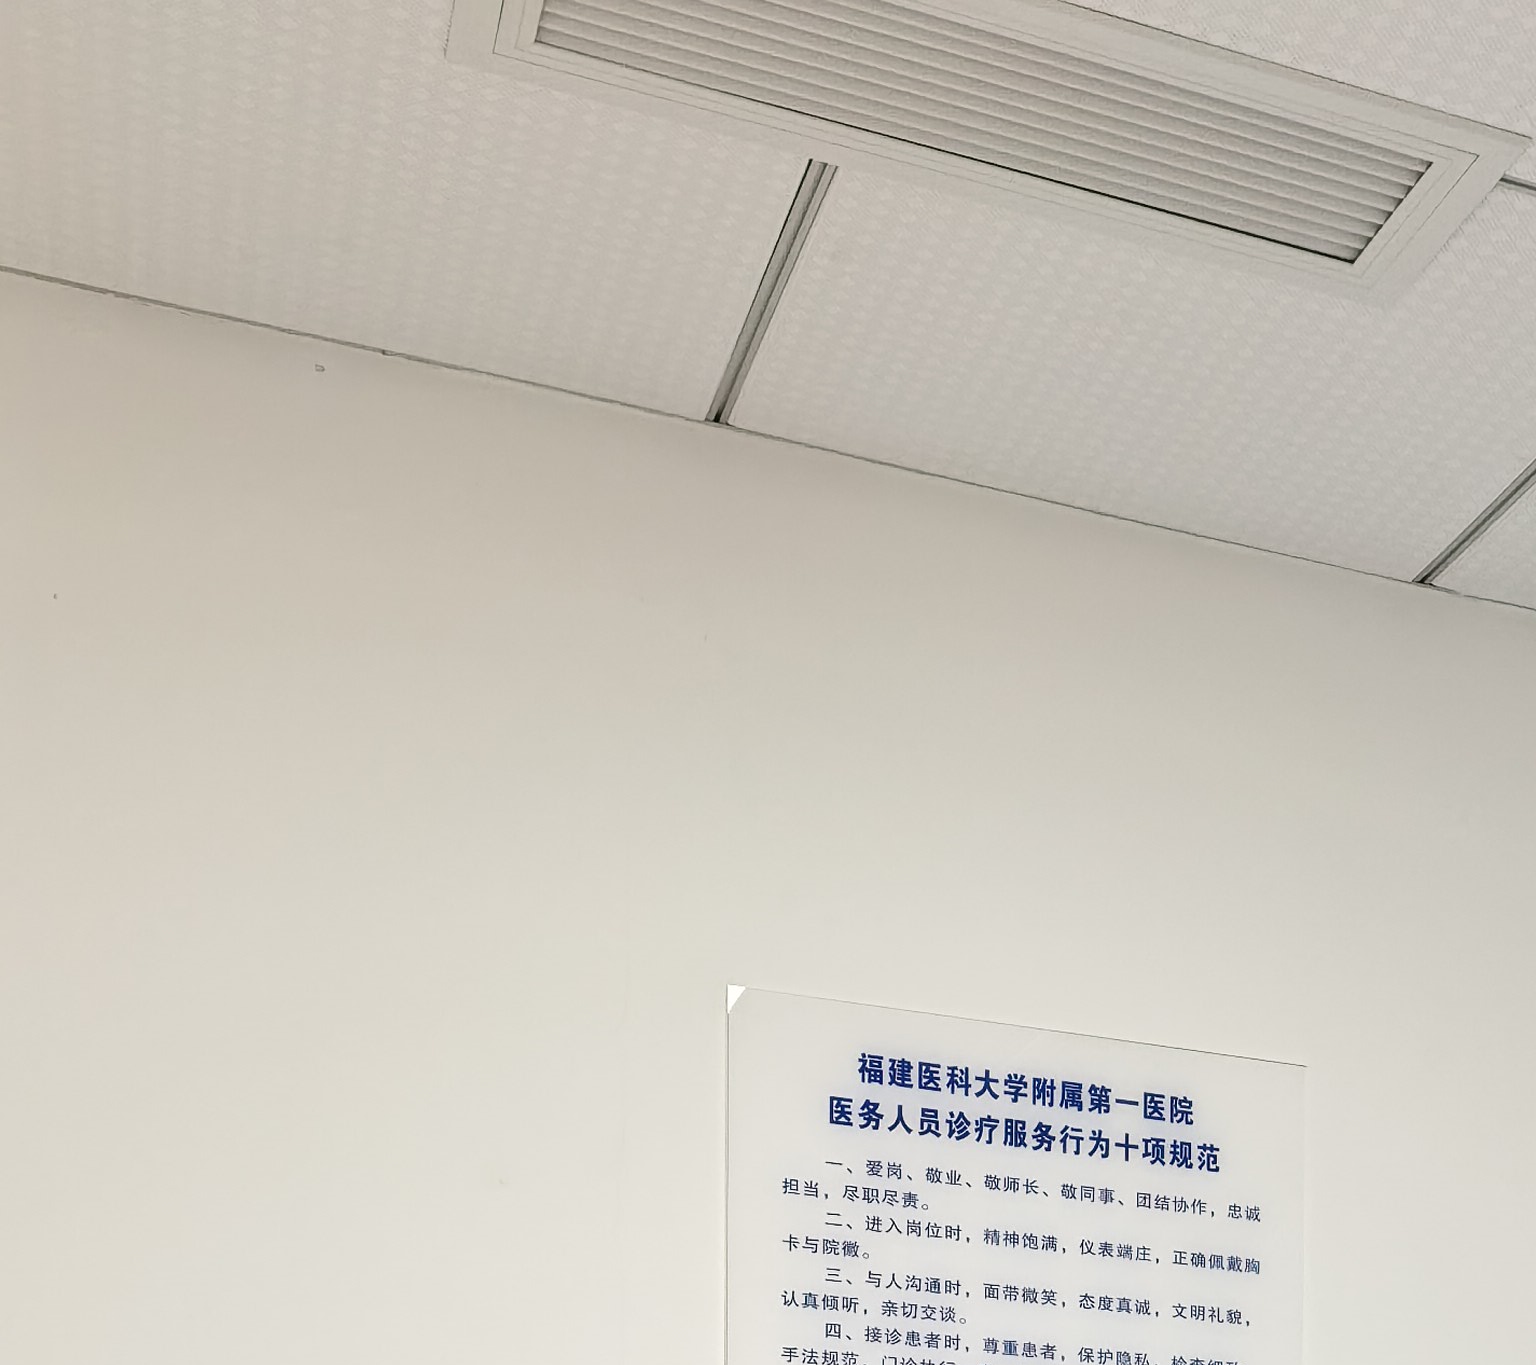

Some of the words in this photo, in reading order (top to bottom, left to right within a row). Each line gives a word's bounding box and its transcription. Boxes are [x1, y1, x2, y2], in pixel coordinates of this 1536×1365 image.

[857, 1052, 1194, 1126] 福建医科大学附属第一医院
[829, 1095, 1220, 1173] 医务人员诊疗服务行为十项规范
[782, 1177, 929, 1211] 担当，尽职尽责。
[781, 1233, 870, 1260] 卡与院徽。
[781, 1290, 967, 1325] 认真倾听，亲切交谈。
